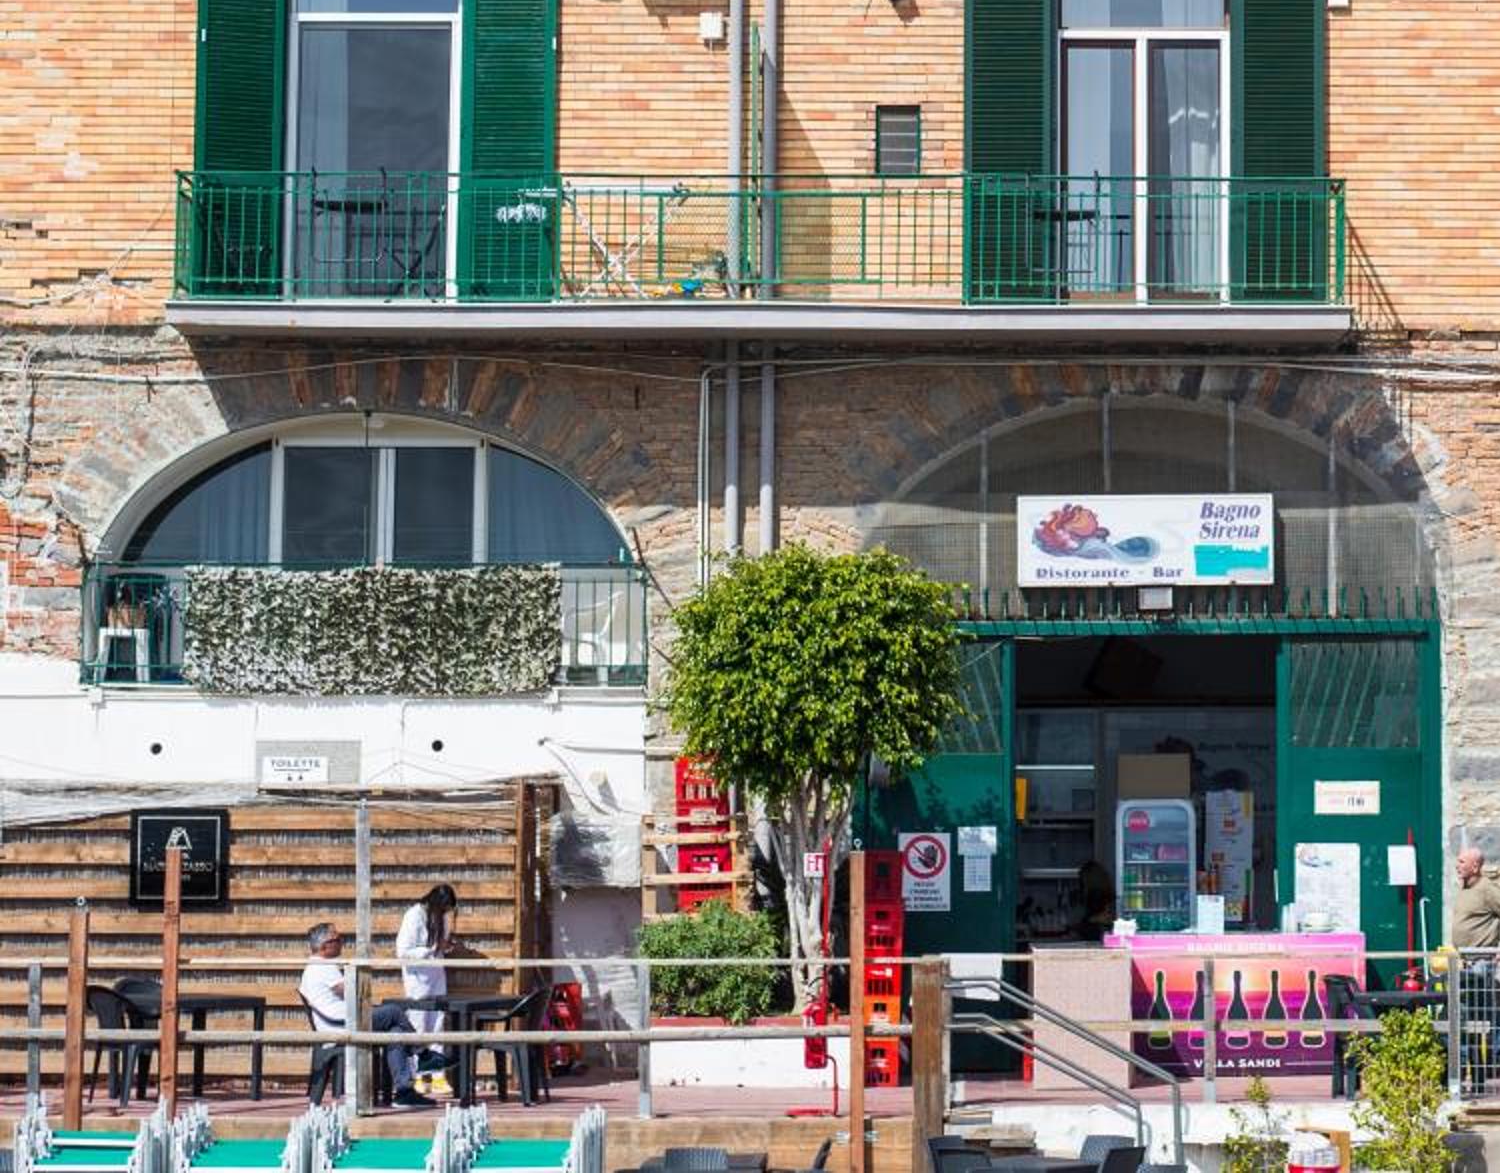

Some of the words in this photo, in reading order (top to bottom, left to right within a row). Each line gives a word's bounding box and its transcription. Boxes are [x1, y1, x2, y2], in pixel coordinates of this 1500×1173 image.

[1200, 501, 1261, 523] Bagno
[1200, 521, 1260, 539] Sirena
[1152, 566, 1184, 578] Bar
[1193, 1058, 1235, 1068] VLA
[1237, 1058, 1281, 1068] SANDI
